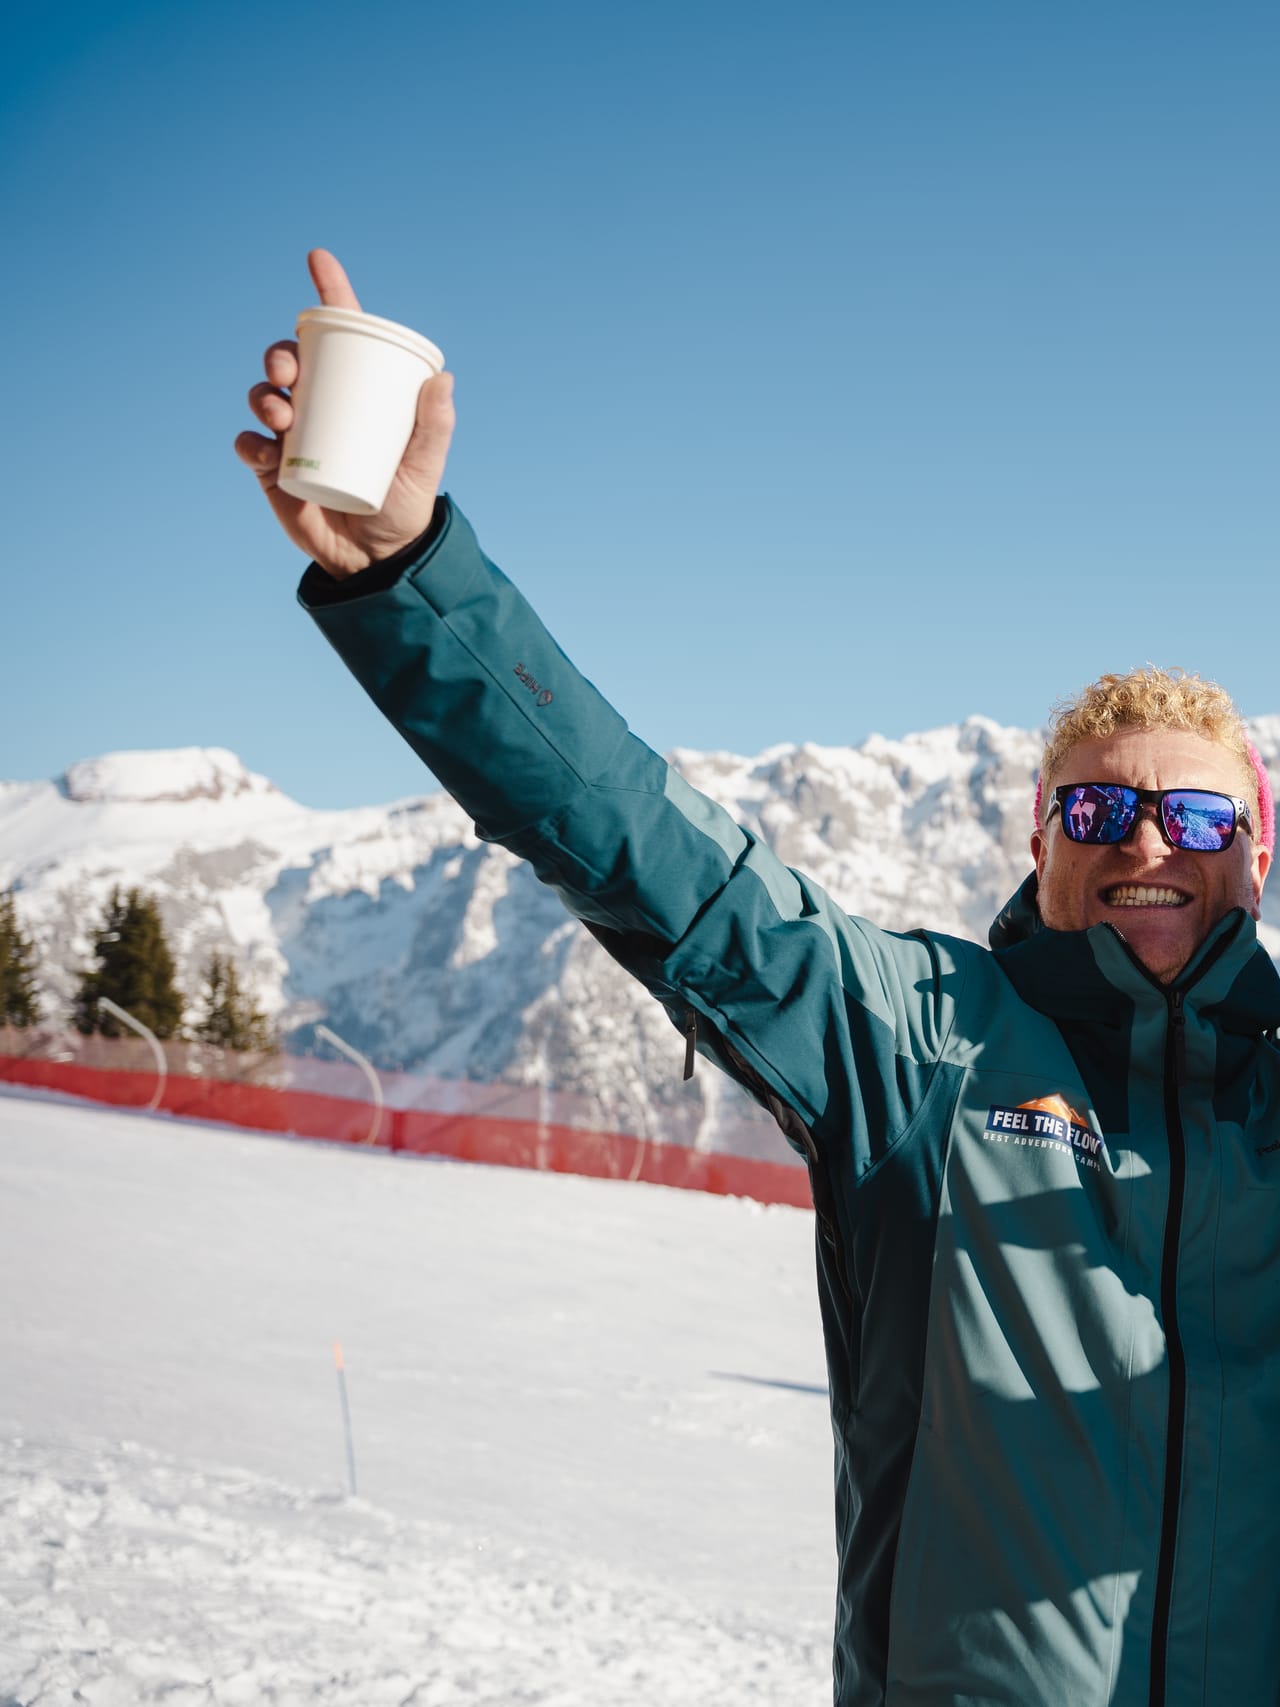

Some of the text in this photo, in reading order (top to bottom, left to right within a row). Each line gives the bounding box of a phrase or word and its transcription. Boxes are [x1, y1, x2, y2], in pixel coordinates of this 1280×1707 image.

[983, 1132, 1101, 1172] BEST ADVENTURE CAMPS
[992, 1110, 1101, 1155] FEEL THE FLOW
